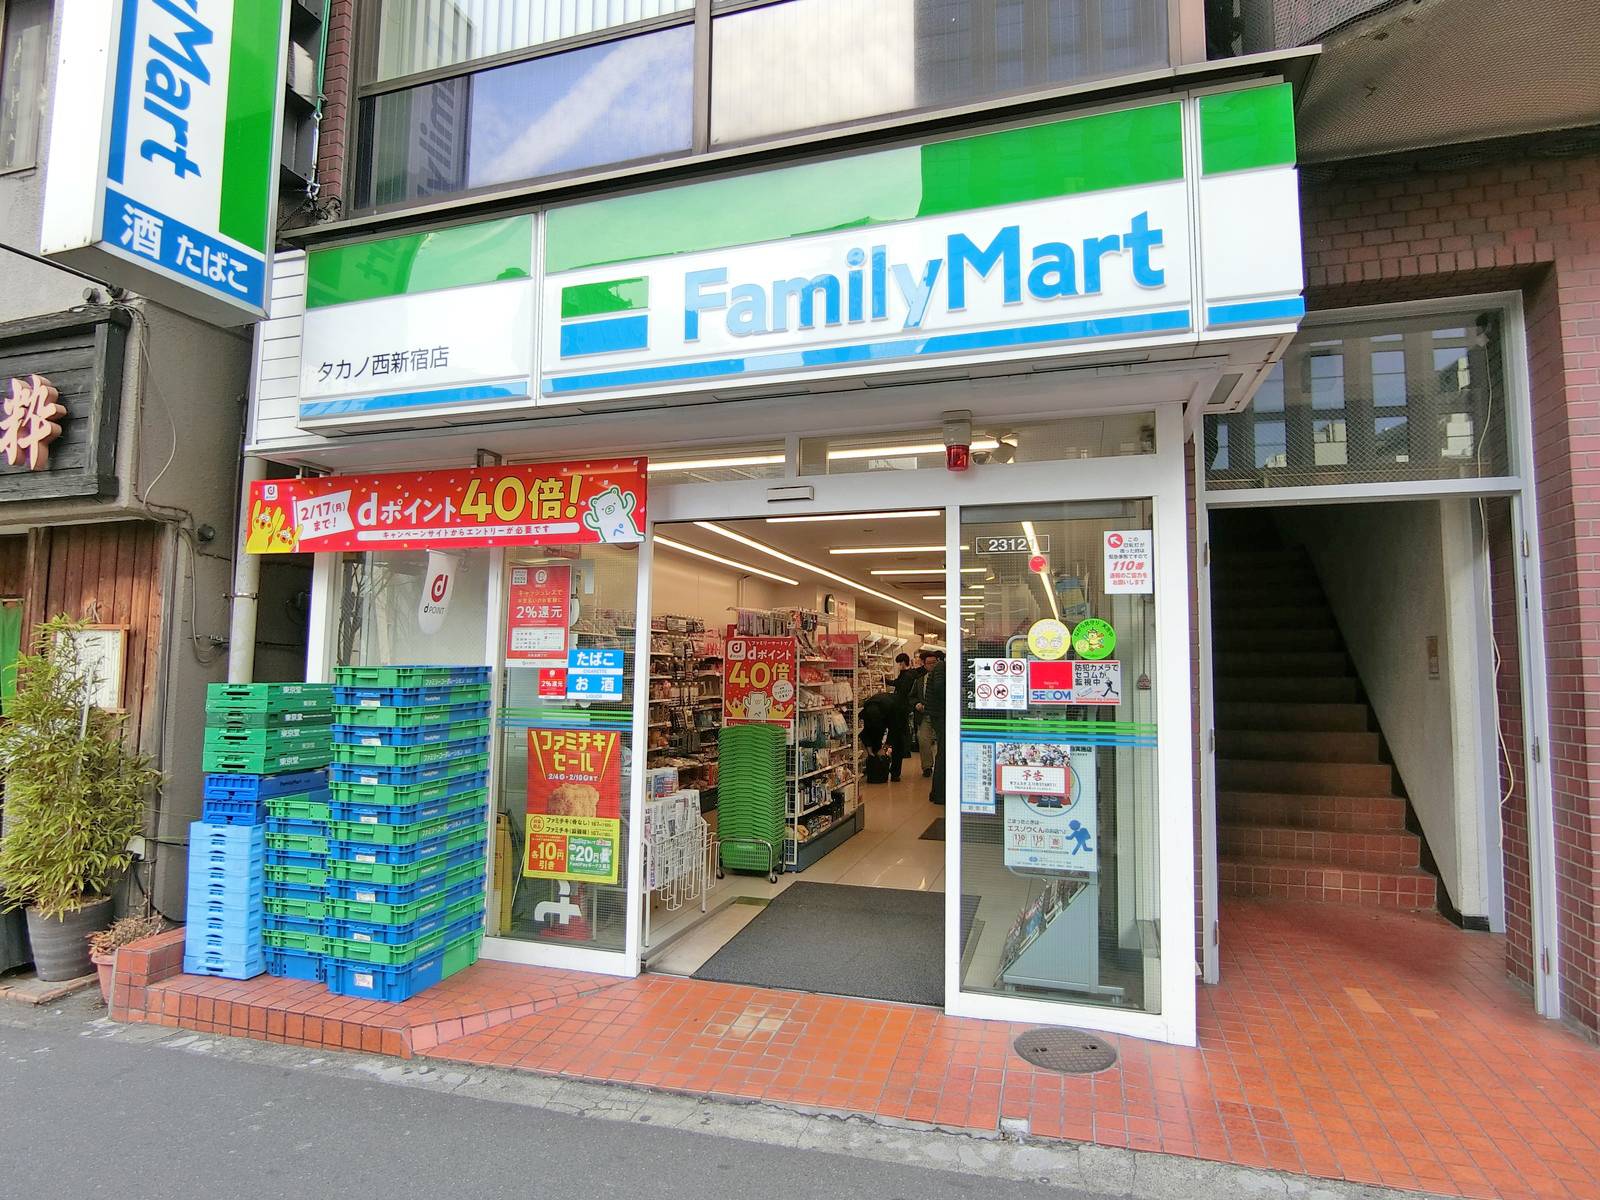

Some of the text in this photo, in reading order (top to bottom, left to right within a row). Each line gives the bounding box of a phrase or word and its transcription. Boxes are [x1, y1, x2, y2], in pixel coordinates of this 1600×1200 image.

[140, 0, 213, 179] Mart
[121, 203, 248, 293] 酒 たばこ
[685, 211, 1165, 343] FamilyMart
[318, 346, 449, 382] タカノ西新宿店
[358, 474, 583, 526] dポイント 40倍!
[301, 502, 345, 521] 2/17(月)
[1113, 561, 1144, 571] 110番
[516, 606, 562, 618] 2%還元
[577, 652, 614, 666] たばこ
[747, 646, 792, 660] dポイント
[729, 662, 789, 689] 40倍
[1032, 690, 1071, 700] SECOM
[540, 731, 606, 752] ファミチキ
[553, 752, 594, 772] セール
[1022, 769, 1044, 781] 予告
[546, 817, 590, 826] ファミチキ(骨なし)
[539, 861, 555, 870] 引き
